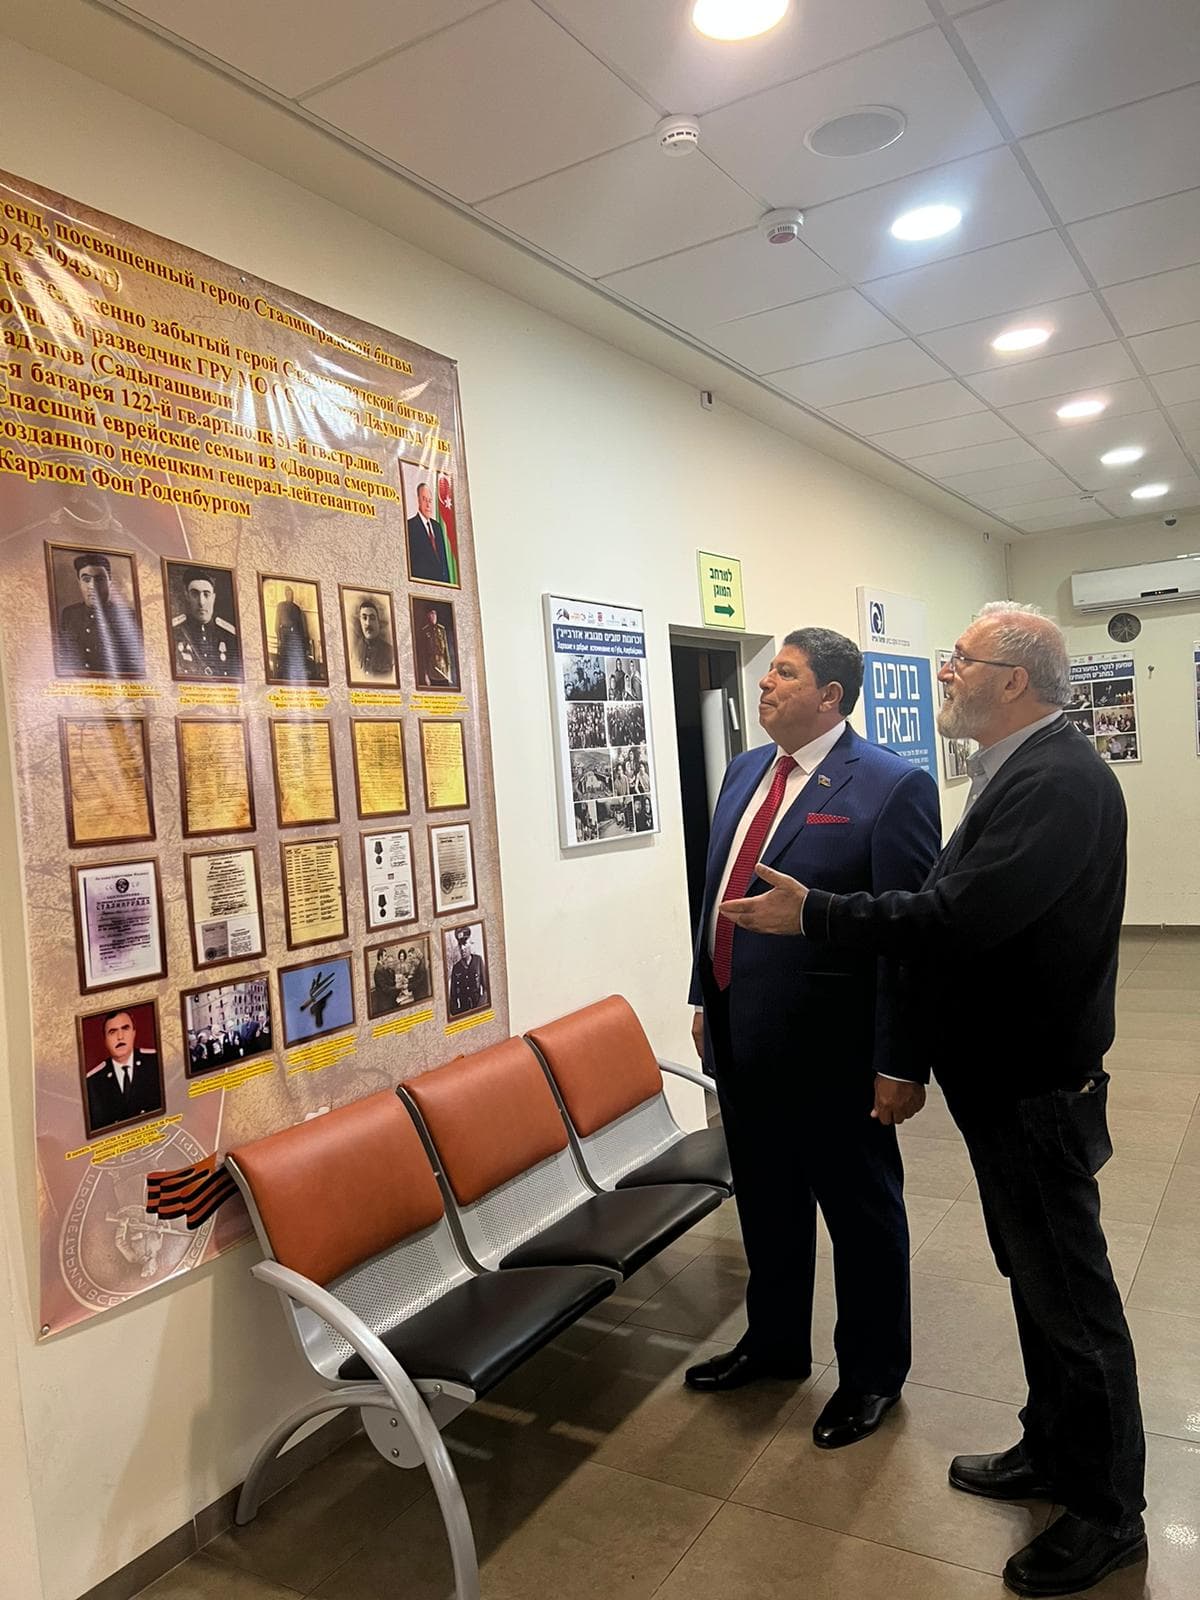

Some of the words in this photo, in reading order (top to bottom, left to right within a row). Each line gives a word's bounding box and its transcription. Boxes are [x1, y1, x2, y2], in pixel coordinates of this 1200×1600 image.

[0, 202, 49, 237] енд,
[55, 223, 195, 289] посвященный
[200, 280, 250, 310] герою
[374, 345, 413, 374] битвы
[92, 328, 192, 372] разведчик
[197, 357, 232, 382] ГРУ
[151, 319, 230, 356] забытый
[235, 347, 279, 373] герой
[31, 363, 115, 403] батарея
[122, 389, 172, 418] 122-й
[277, 431, 307, 455] 51-й
[0, 449, 85, 484] Карлом
[92, 468, 134, 493] Фон
[140, 477, 251, 516] Роденбургом
[103, 415, 201, 451] еврейские
[205, 441, 254, 464] семьи
[258, 455, 276, 470] из
[280, 458, 340, 486] «Дворца
[344, 476, 401, 502] смерти»,
[122, 448, 214, 481] немецким
[219, 470, 376, 516] генерал-лейтенантом
[709, 567, 733, 582] למרחב
[713, 584, 732, 598] המוגן
[872, 661, 920, 700] ברוכים
[875, 706, 921, 745] הבאים
